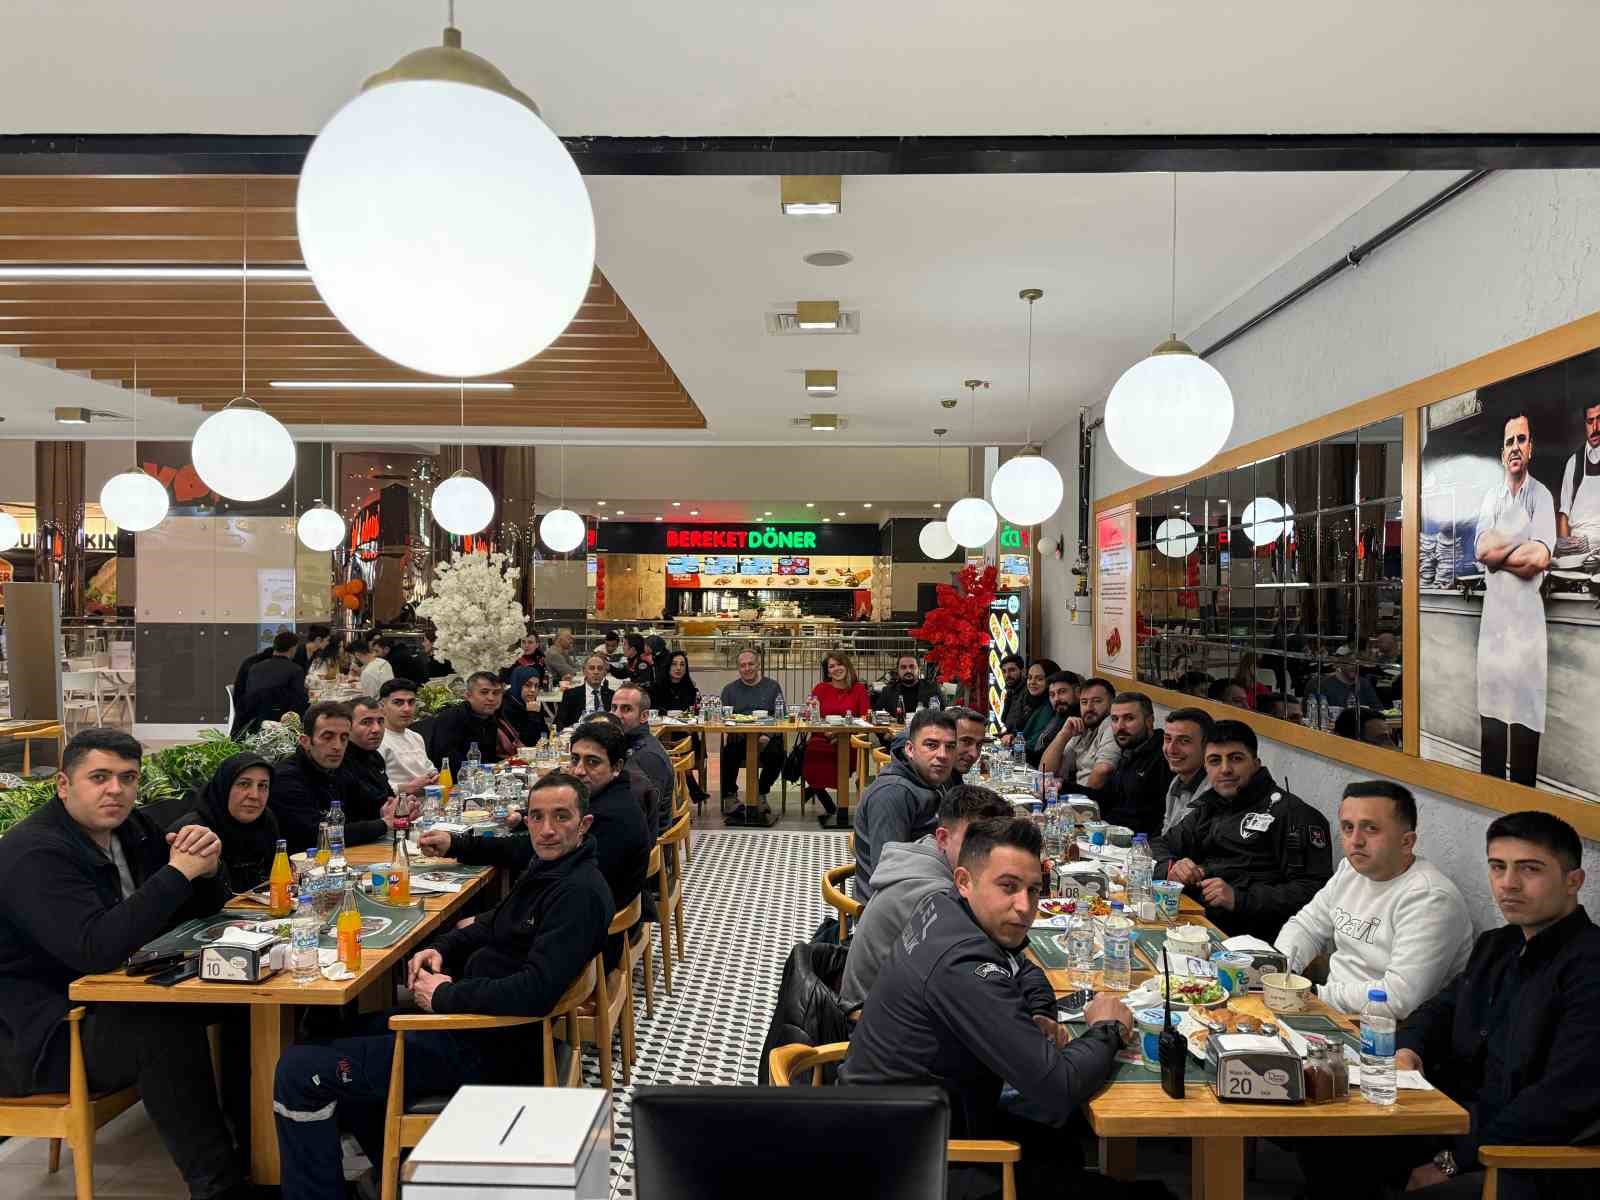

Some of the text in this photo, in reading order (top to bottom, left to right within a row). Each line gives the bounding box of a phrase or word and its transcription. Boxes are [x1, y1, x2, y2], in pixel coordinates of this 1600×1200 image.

[84, 533, 118, 549] KIN
[666, 527, 817, 549] BEREKET DÖNER
[206, 962, 220, 977] 10
[1230, 1077, 1252, 1095] 20
